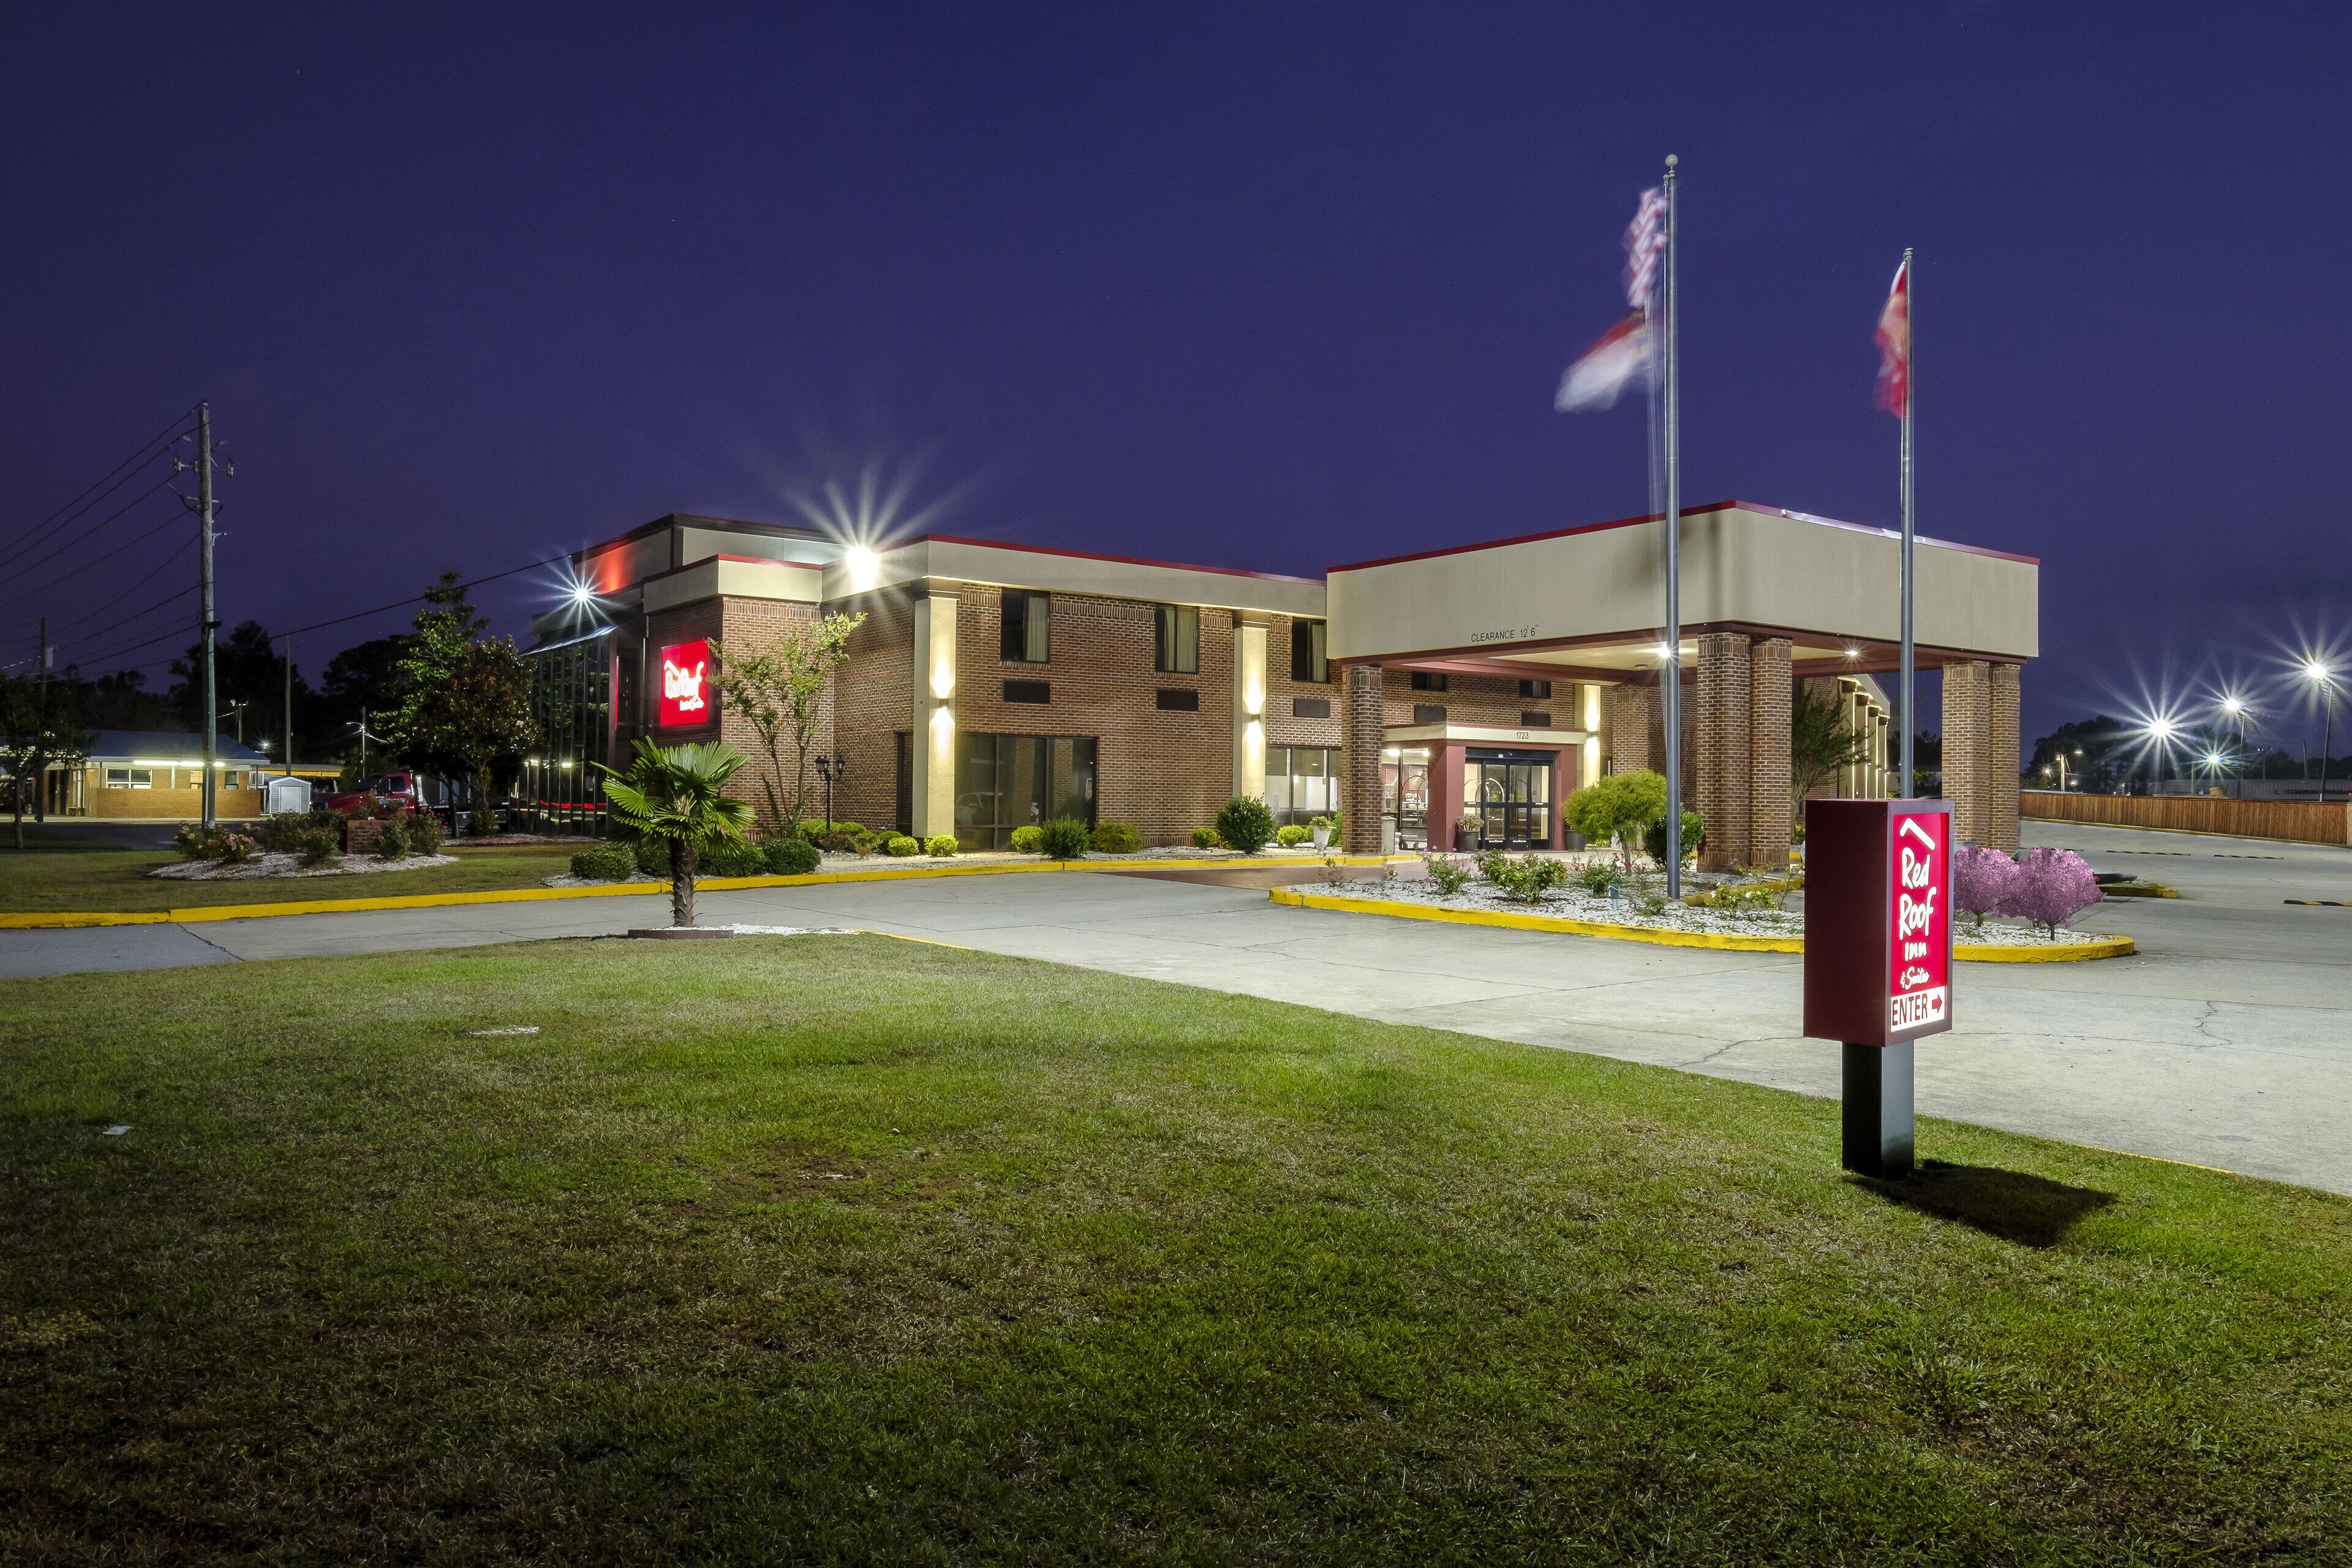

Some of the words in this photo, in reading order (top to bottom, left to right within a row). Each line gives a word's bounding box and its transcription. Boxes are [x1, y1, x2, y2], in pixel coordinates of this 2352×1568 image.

[1471, 630, 1515, 643] CLEARANCE
[1902, 847, 1931, 889] Red
[1899, 886, 1937, 941] Roof
[1904, 941, 1927, 962] Inn
[1892, 993, 1929, 1027] ENTER
